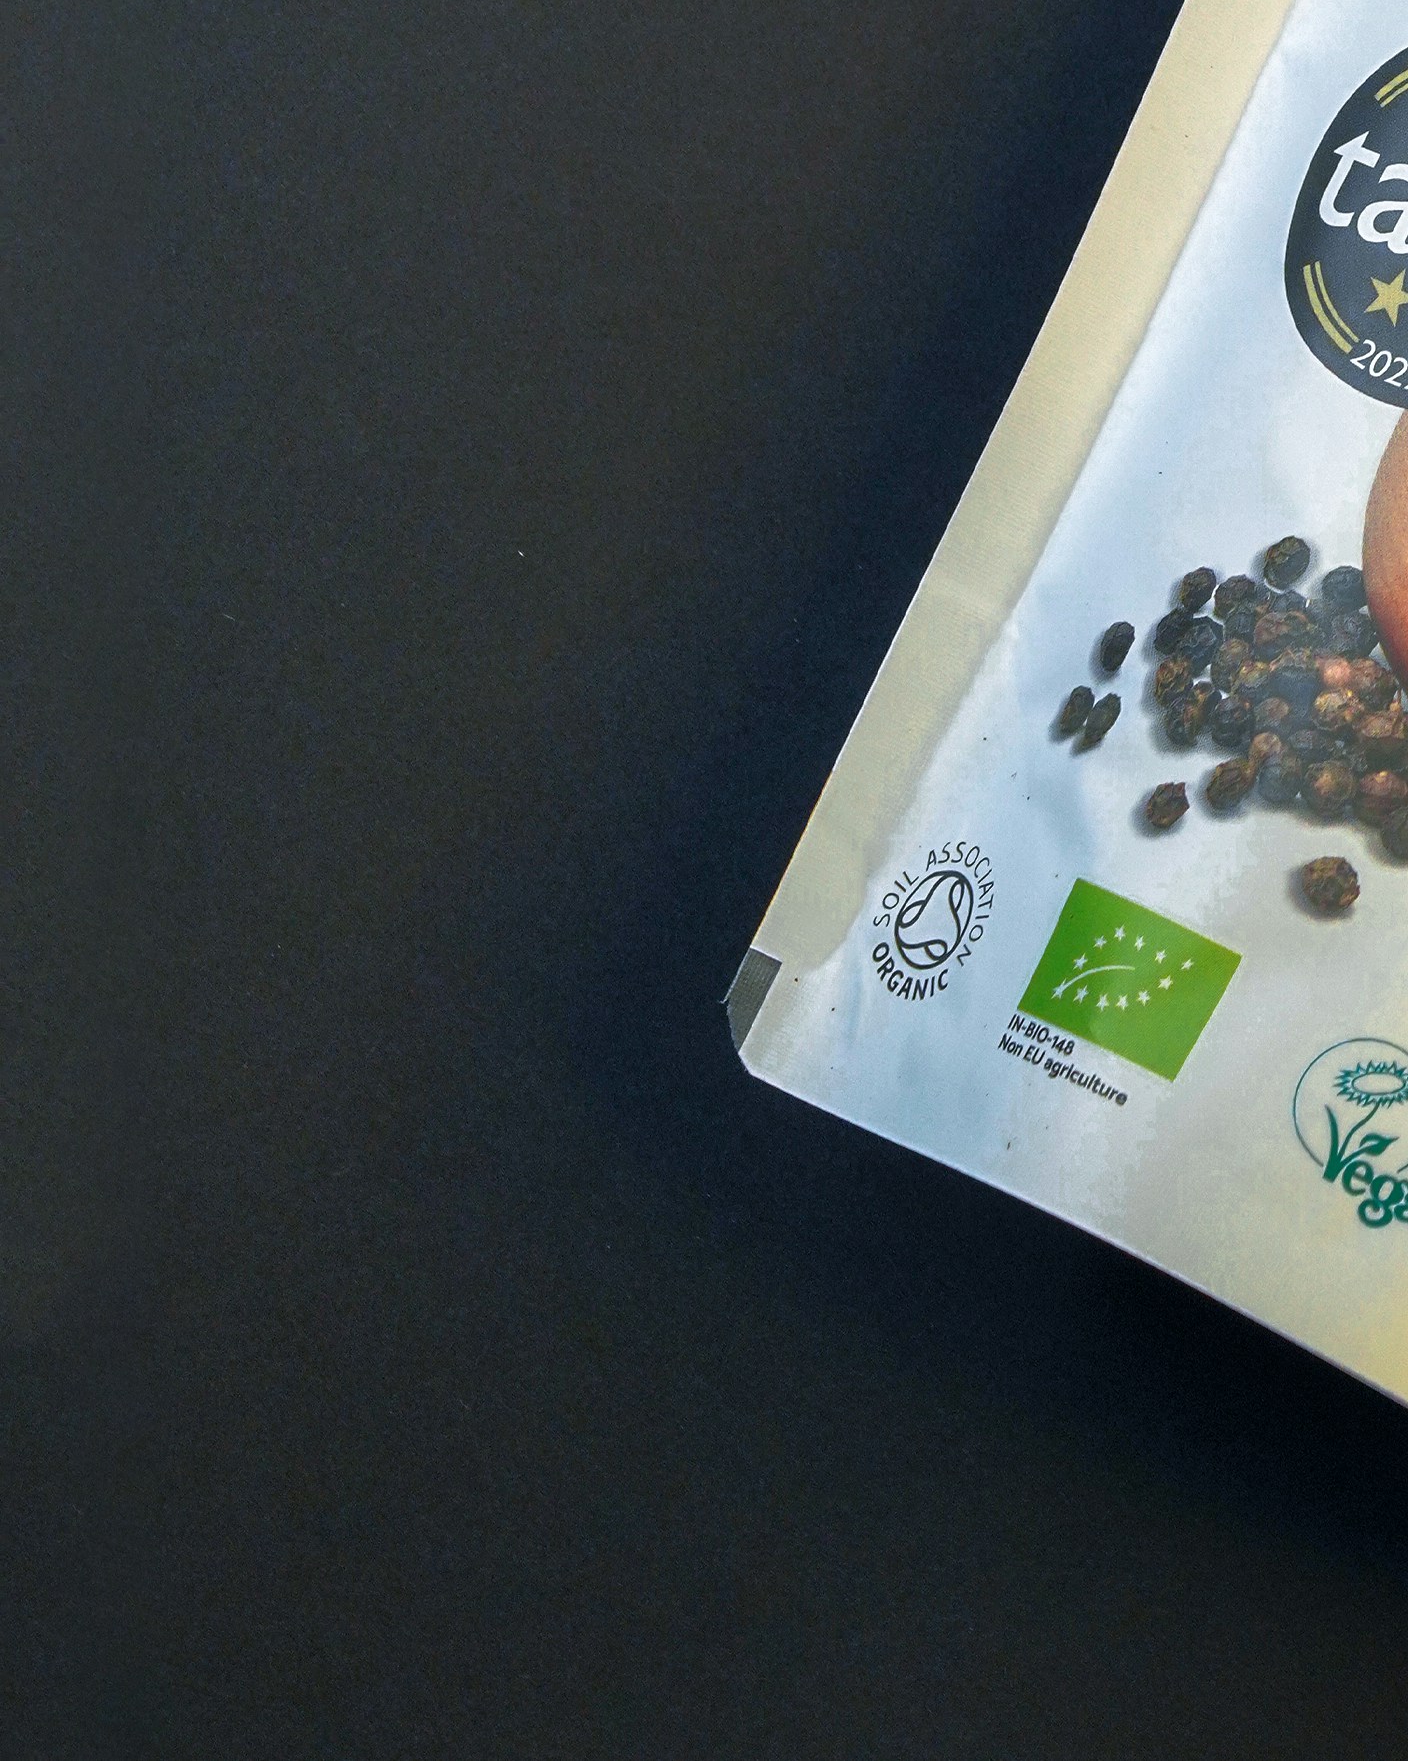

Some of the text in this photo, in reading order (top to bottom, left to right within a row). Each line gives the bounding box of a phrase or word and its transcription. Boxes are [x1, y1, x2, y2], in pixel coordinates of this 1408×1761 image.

[873, 841, 995, 967] SOIL ASSOCIATION
[872, 942, 948, 1001] ORGANIC
[1007, 1013, 1075, 1056] IN-BIO-148
[998, 1033, 1128, 1106] Non EU agriculture
